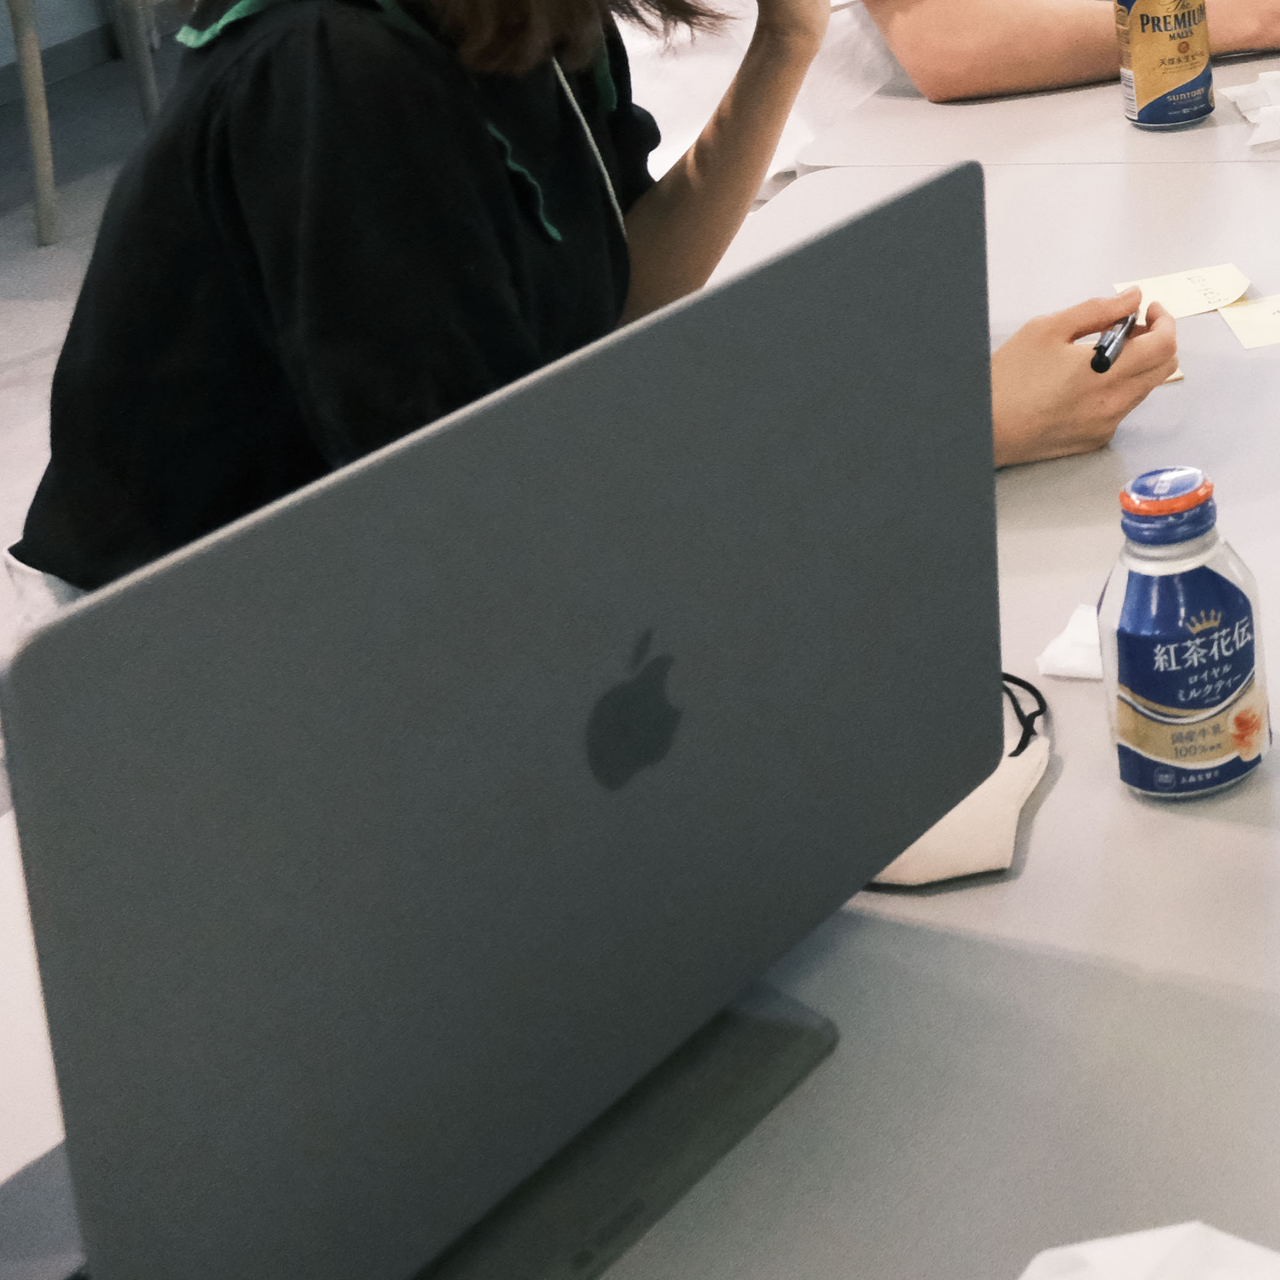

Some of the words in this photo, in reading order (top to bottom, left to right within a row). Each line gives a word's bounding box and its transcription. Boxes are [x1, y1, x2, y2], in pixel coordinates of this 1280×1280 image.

[1166, 87, 1206, 102] SUNTORY
[1153, 616, 1252, 672] 紅茶花伝
[1188, 663, 1232, 685] ロイヤル
[1178, 674, 1241, 701] ミルクティー
